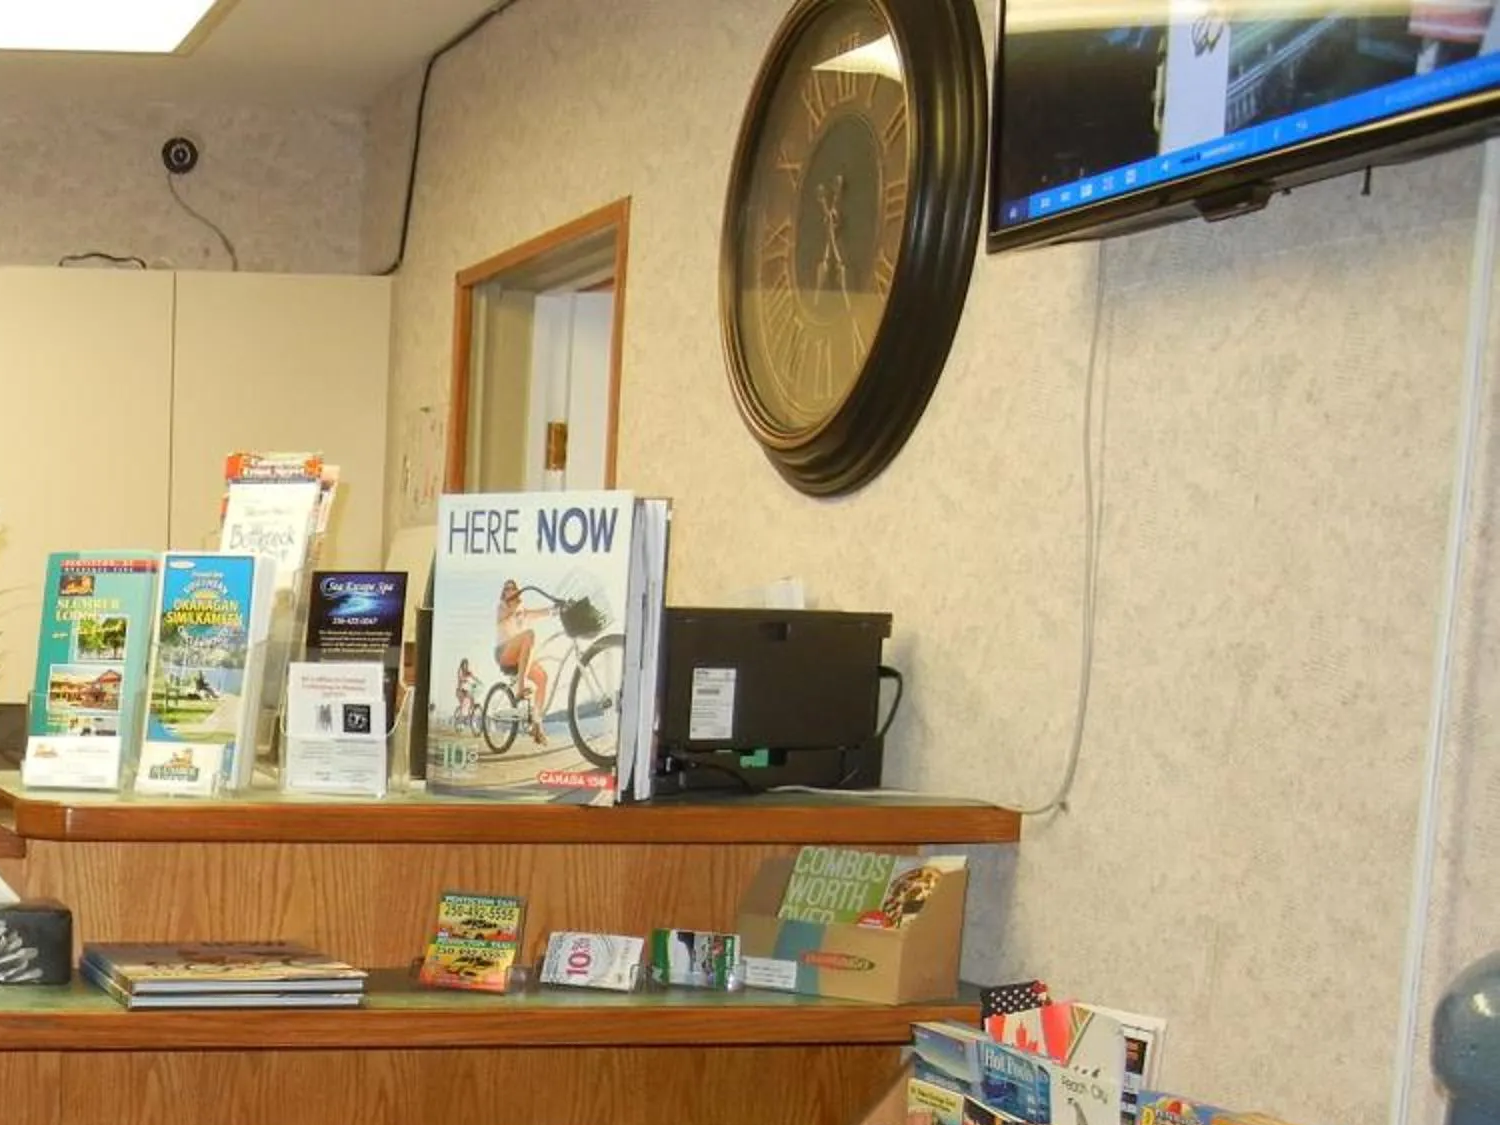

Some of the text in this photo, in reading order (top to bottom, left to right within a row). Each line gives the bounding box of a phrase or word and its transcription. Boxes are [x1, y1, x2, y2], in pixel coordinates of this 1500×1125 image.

[449, 507, 619, 556] HERE NOW
[379, 582, 395, 595] Spa
[539, 771, 585, 786] CANADA
[794, 846, 890, 882] COMBOS
[786, 874, 869, 911] WORTH
